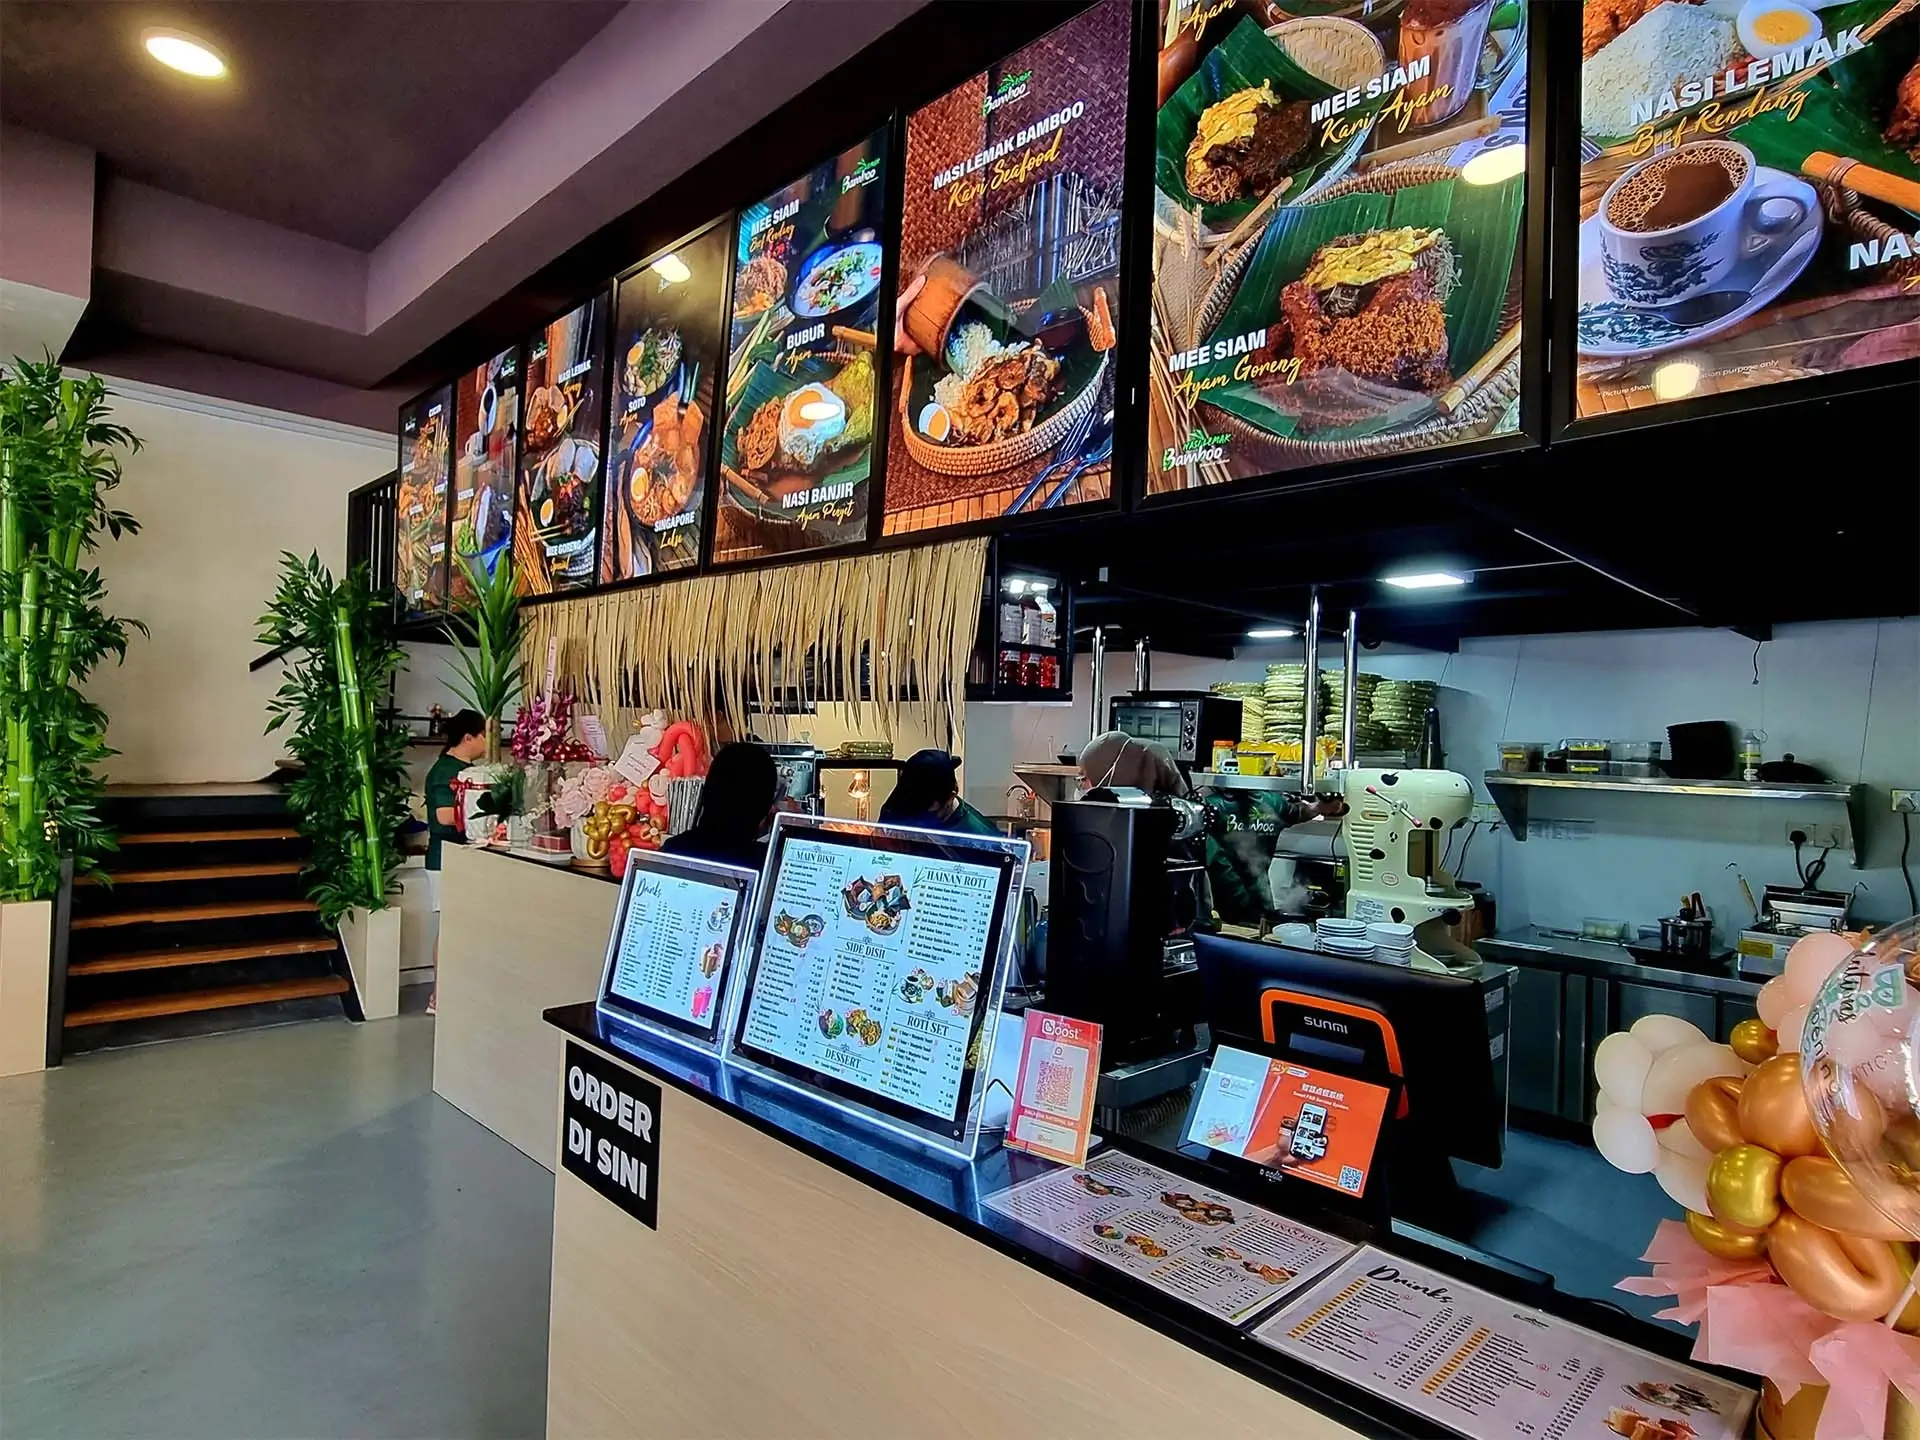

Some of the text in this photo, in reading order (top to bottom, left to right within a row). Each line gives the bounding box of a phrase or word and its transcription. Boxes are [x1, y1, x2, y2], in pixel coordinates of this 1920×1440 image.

[1311, 55, 1431, 124] MEE SIAM
[1630, 24, 1872, 126] NASI LEMAK
[983, 83, 1027, 118] Bamboo
[1319, 115, 1376, 147] Kari
[1378, 85, 1454, 133] Ayam
[1629, 88, 1811, 156] Beef Rendang
[933, 100, 1085, 191] NASI LEMAK BAMBOO
[949, 128, 1064, 211] Kari Seafood
[772, 199, 800, 225] SIAM
[1850, 231, 1920, 270] NA
[786, 323, 825, 350] BUBUR
[1169, 329, 1267, 373] MEE SIAM
[785, 348, 812, 374] Ayam
[1172, 354, 1305, 410] Ayam Goreng
[628, 396, 646, 413] SOTO
[1163, 444, 1223, 472] Bamboo
[782, 481, 854, 509] NASI BANJIR
[654, 511, 695, 533] SINGAPORE
[795, 507, 820, 531] Ayam
[796, 850, 835, 866] MAIN DISH
[926, 870, 988, 889] HAINAN ROTI
[845, 941, 886, 960] SIDE DISH
[907, 1015, 949, 1037] ROTI SET
[825, 1047, 861, 1069] DESSERT
[569, 1066, 653, 1143] ORDER
[568, 1117, 648, 1200] DI SINI
[1366, 1264, 1455, 1304] Drinks
